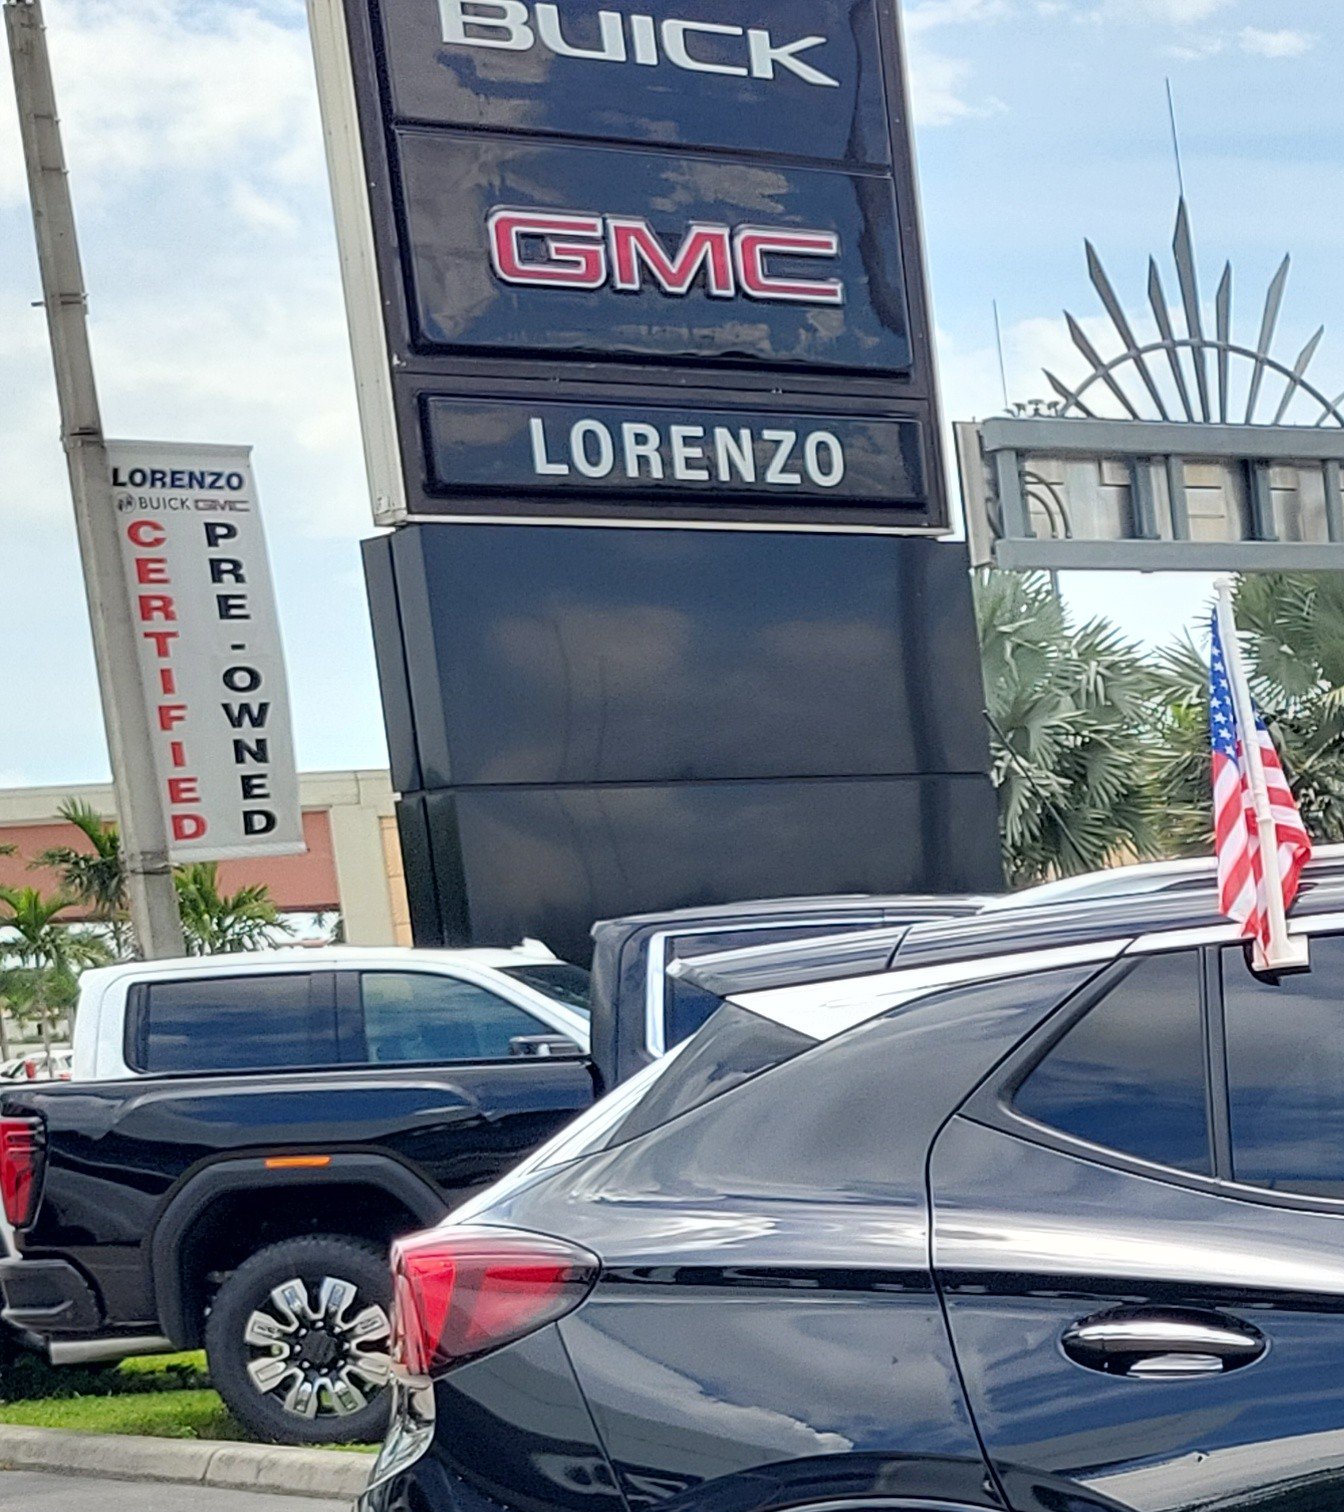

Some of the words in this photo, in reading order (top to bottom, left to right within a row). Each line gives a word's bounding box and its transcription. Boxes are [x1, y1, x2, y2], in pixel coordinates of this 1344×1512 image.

[438, 0, 840, 87] BUICK
[488, 207, 843, 305] GMC
[112, 467, 244, 491] LORENZO
[528, 417, 846, 487] LORENZO
[138, 496, 191, 511] BUICK
[194, 499, 250, 512] GMC
[127, 520, 207, 841] CERTIFIED
[204, 521, 277, 836] PRE-OWNED
